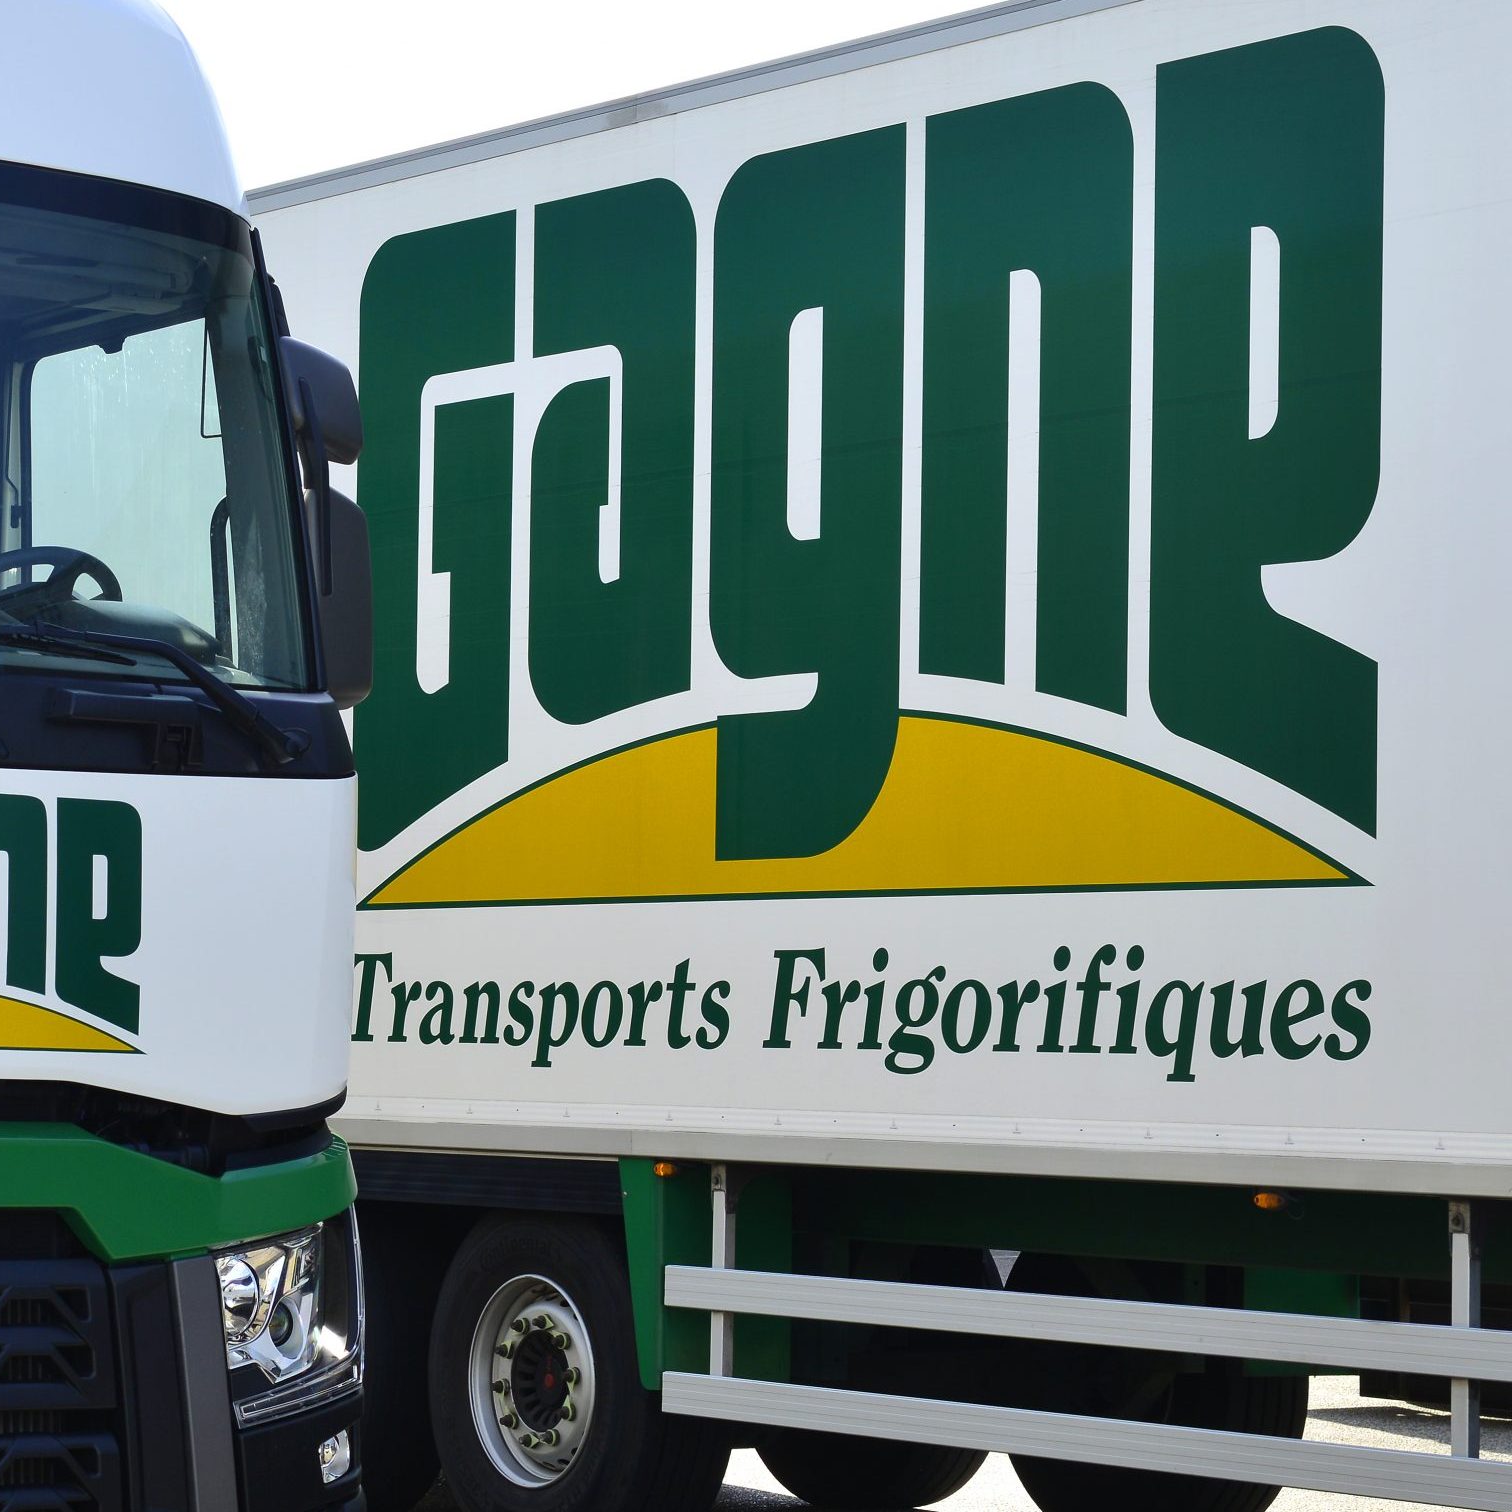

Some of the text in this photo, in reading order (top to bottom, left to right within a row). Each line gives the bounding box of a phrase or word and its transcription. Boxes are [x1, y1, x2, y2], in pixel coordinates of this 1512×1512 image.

[353, 25, 1385, 862] Gagne
[350, 943, 1372, 1083] Transports Frigorifiques
